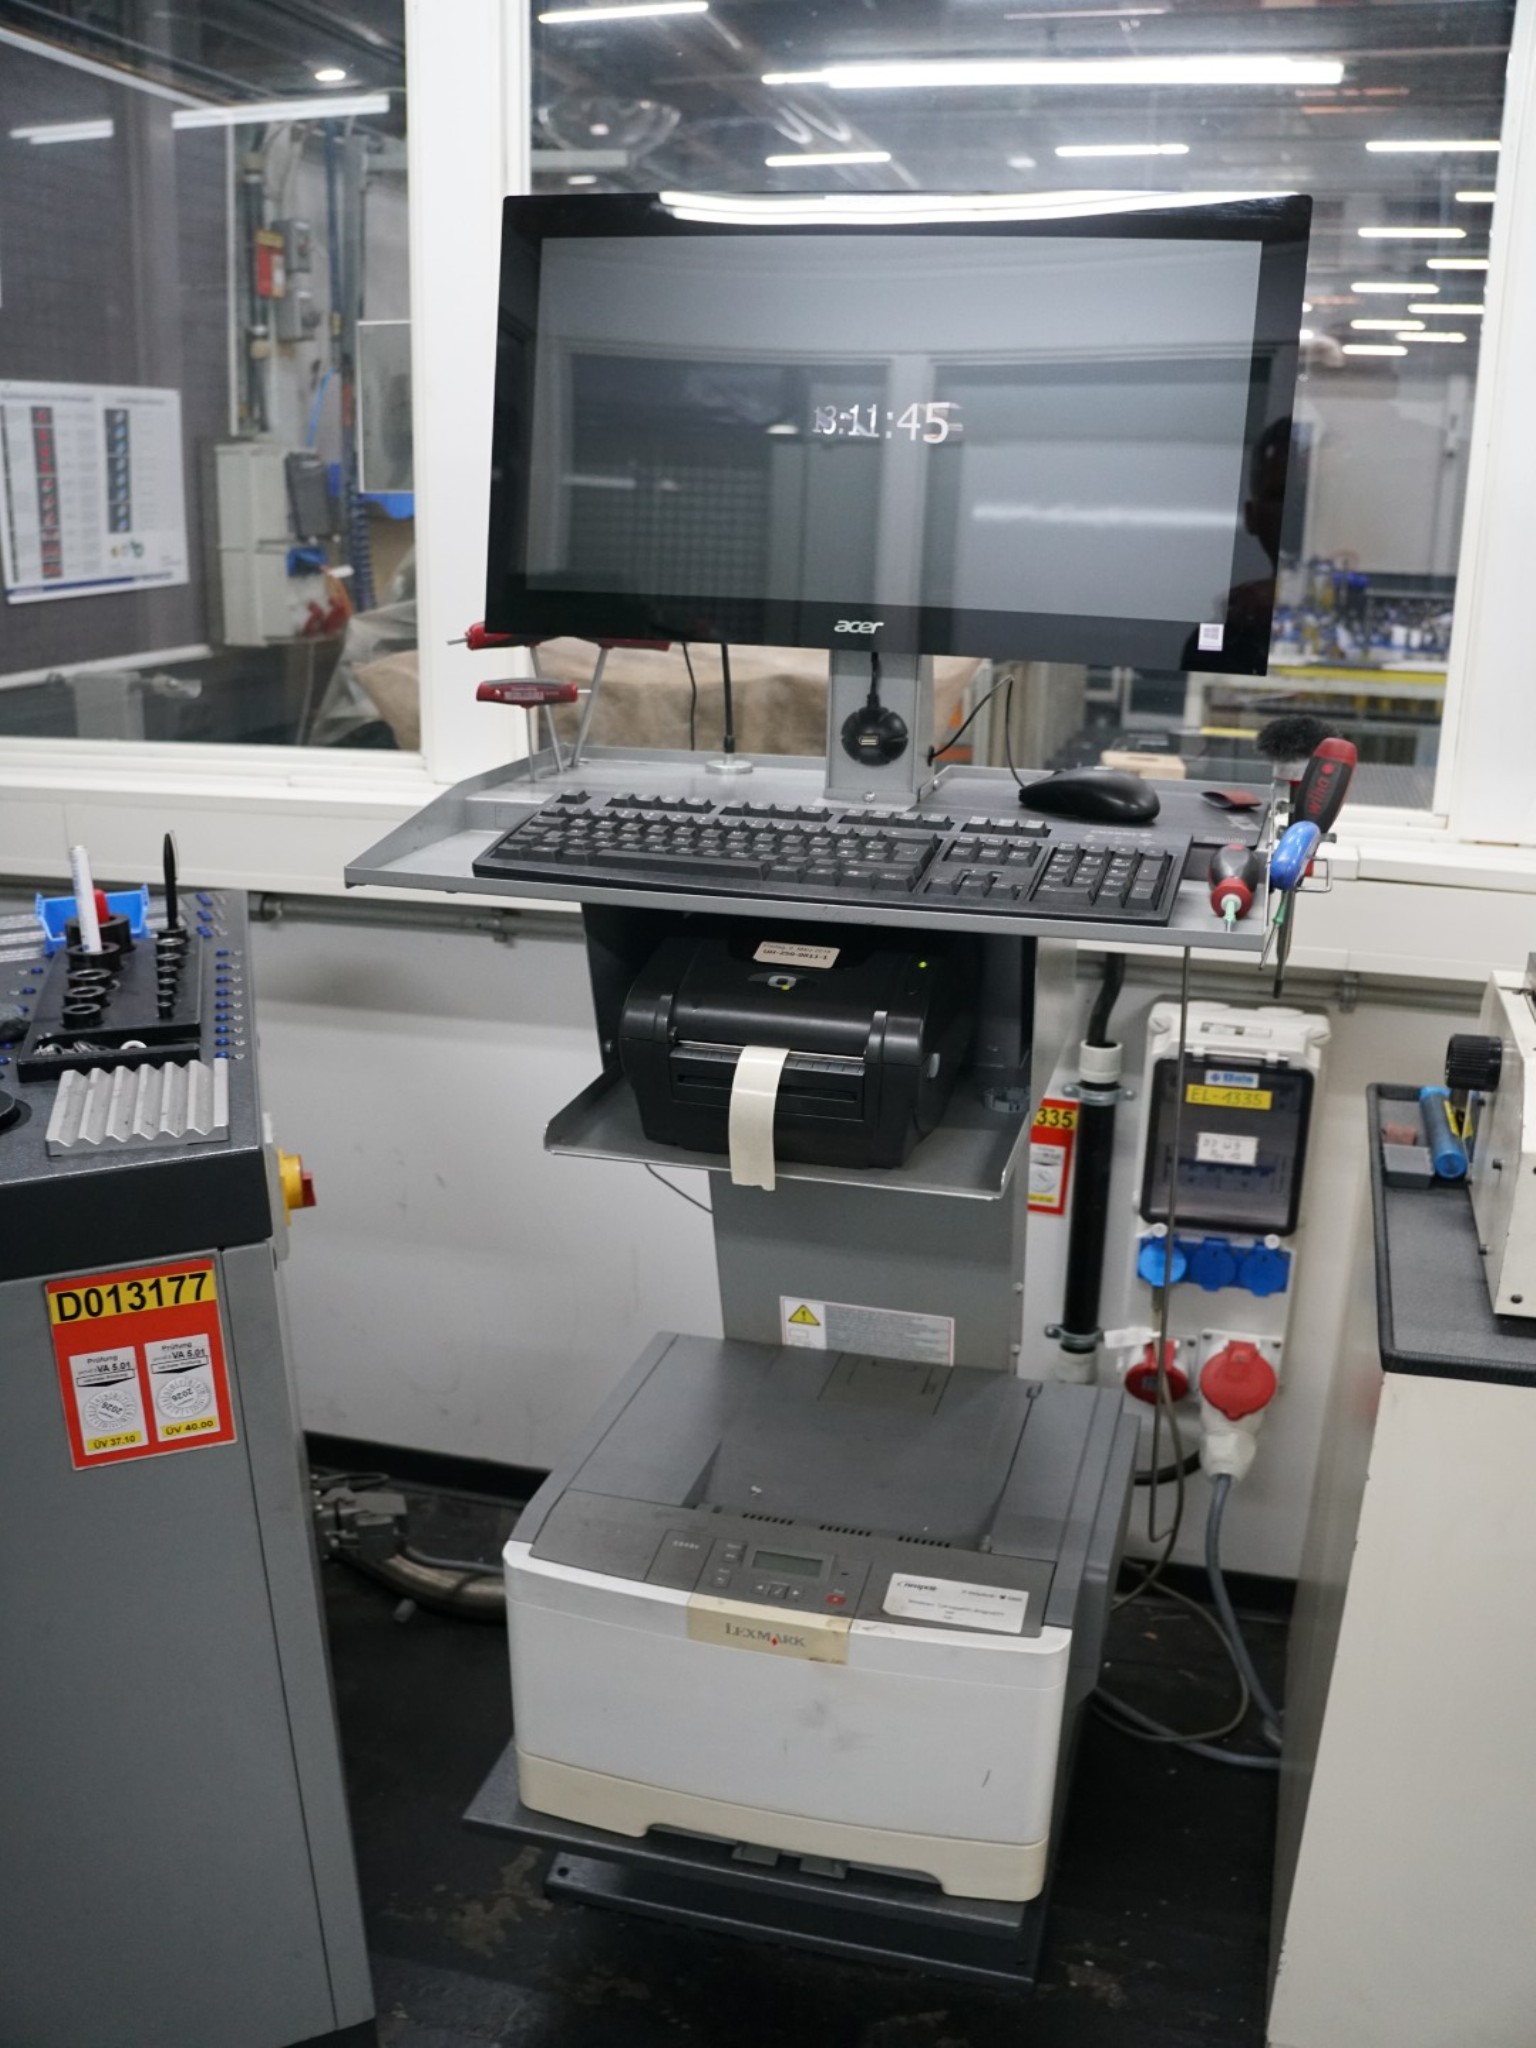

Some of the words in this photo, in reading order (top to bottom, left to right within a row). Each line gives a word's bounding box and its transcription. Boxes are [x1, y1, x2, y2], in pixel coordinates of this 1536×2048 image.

[813, 402, 949, 444] 13:11:45
[834, 619, 885, 634] acer
[56, 1272, 208, 1322] D013177
[172, 1351, 184, 1359] VA
[185, 1420, 214, 1431] 40.00
[725, 1622, 806, 1648] LEXMARK
